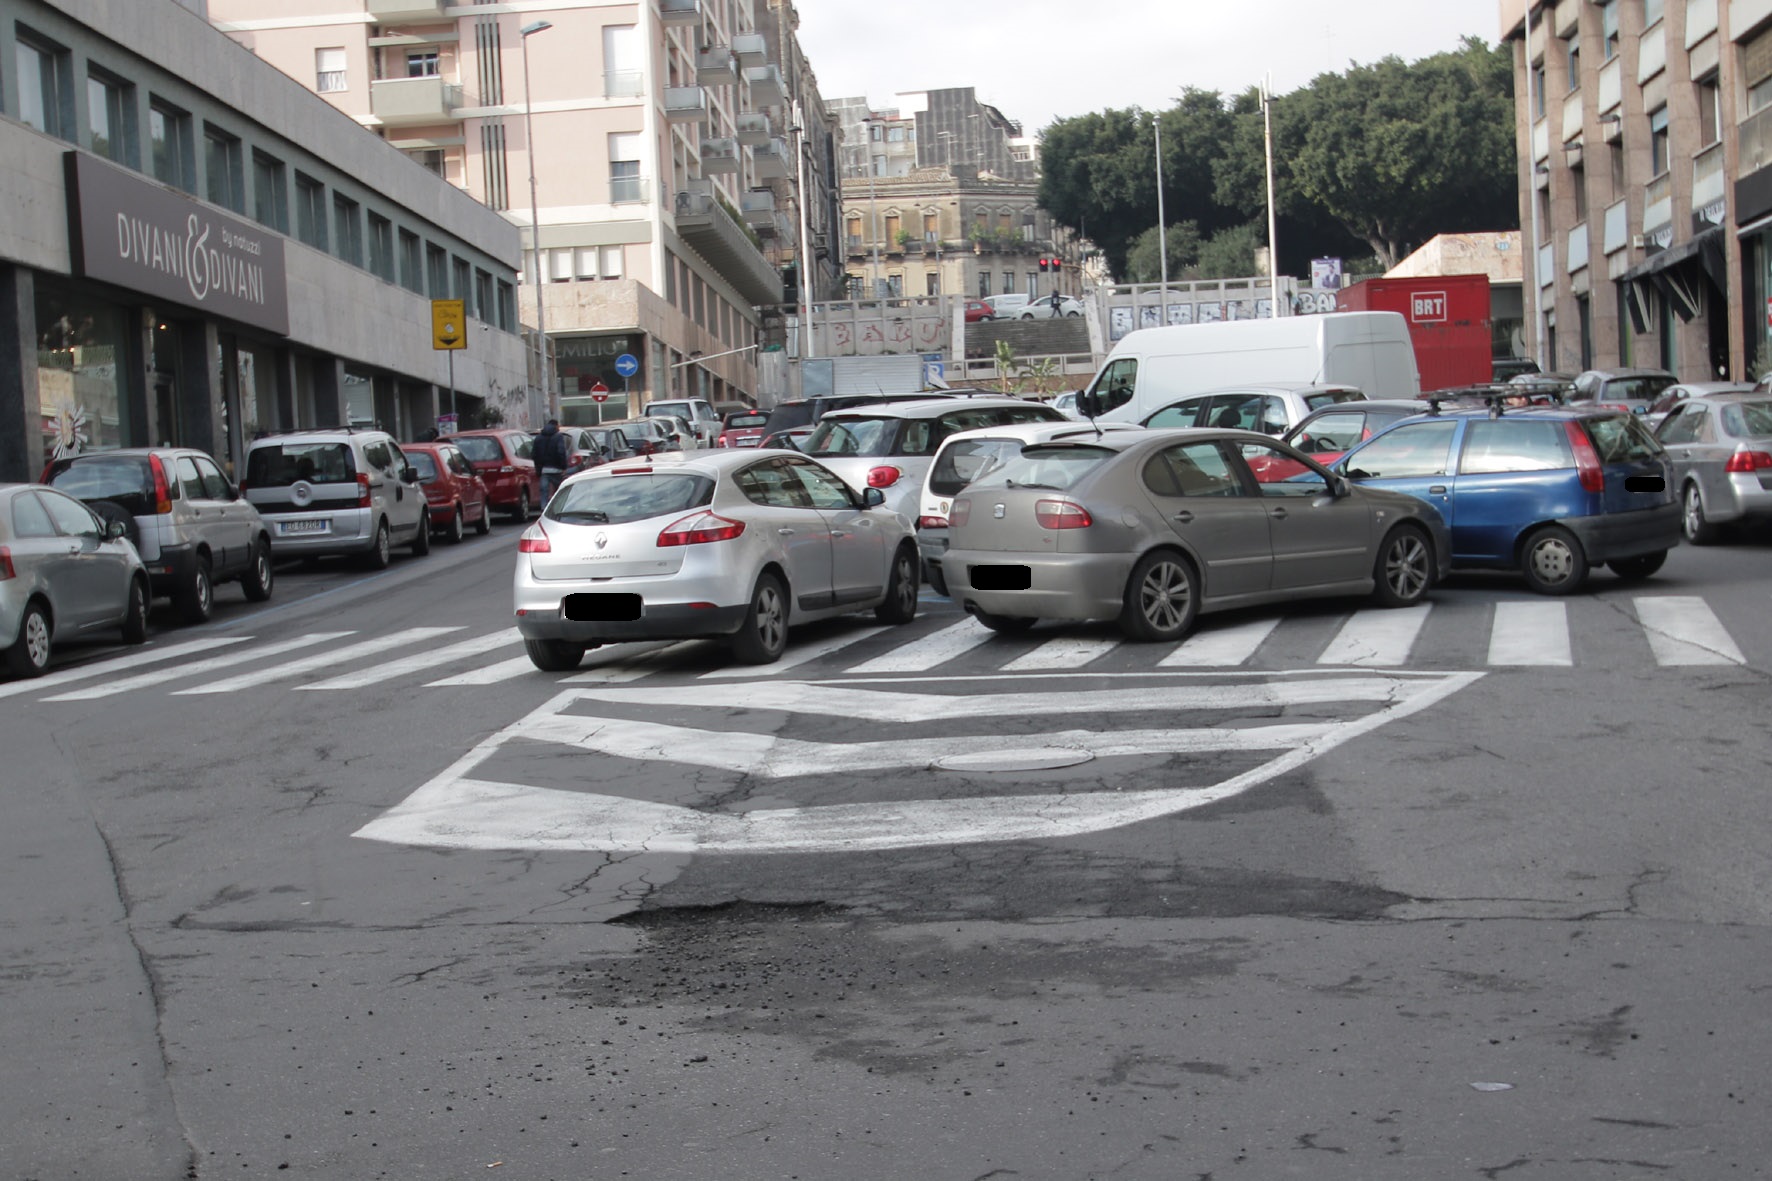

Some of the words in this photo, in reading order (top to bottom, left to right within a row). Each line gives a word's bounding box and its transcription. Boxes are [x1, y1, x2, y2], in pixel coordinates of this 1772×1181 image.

[222, 226, 233, 248] by
[117, 212, 184, 279] DIVANI
[185, 213, 210, 300] &
[210, 248, 265, 305] DIVANI
[1414, 298, 1443, 316] BRT
